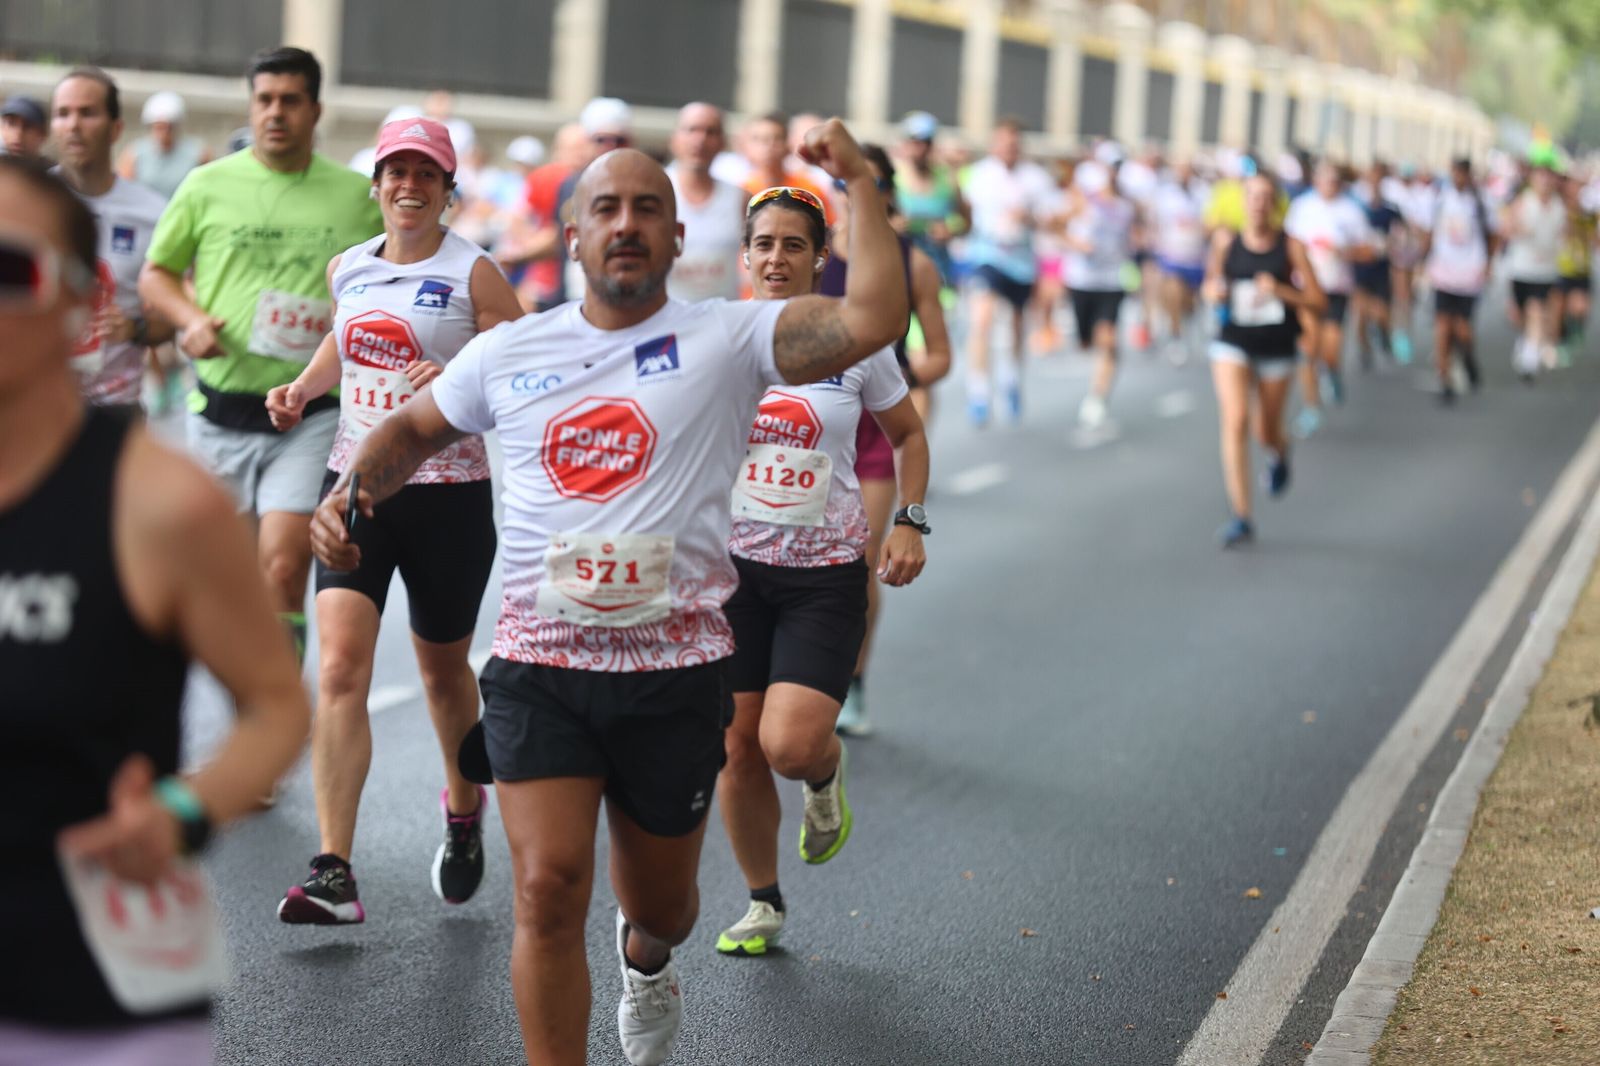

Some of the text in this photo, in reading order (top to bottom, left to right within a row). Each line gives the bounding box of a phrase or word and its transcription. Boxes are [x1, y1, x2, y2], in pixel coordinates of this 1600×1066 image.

[351, 326, 412, 358] PONLE
[349, 342, 409, 371] FRENO
[558, 425, 642, 453] PONLE
[556, 446, 635, 473] FRENO
[746, 463, 816, 489] 1120
[575, 557, 640, 584] 571
